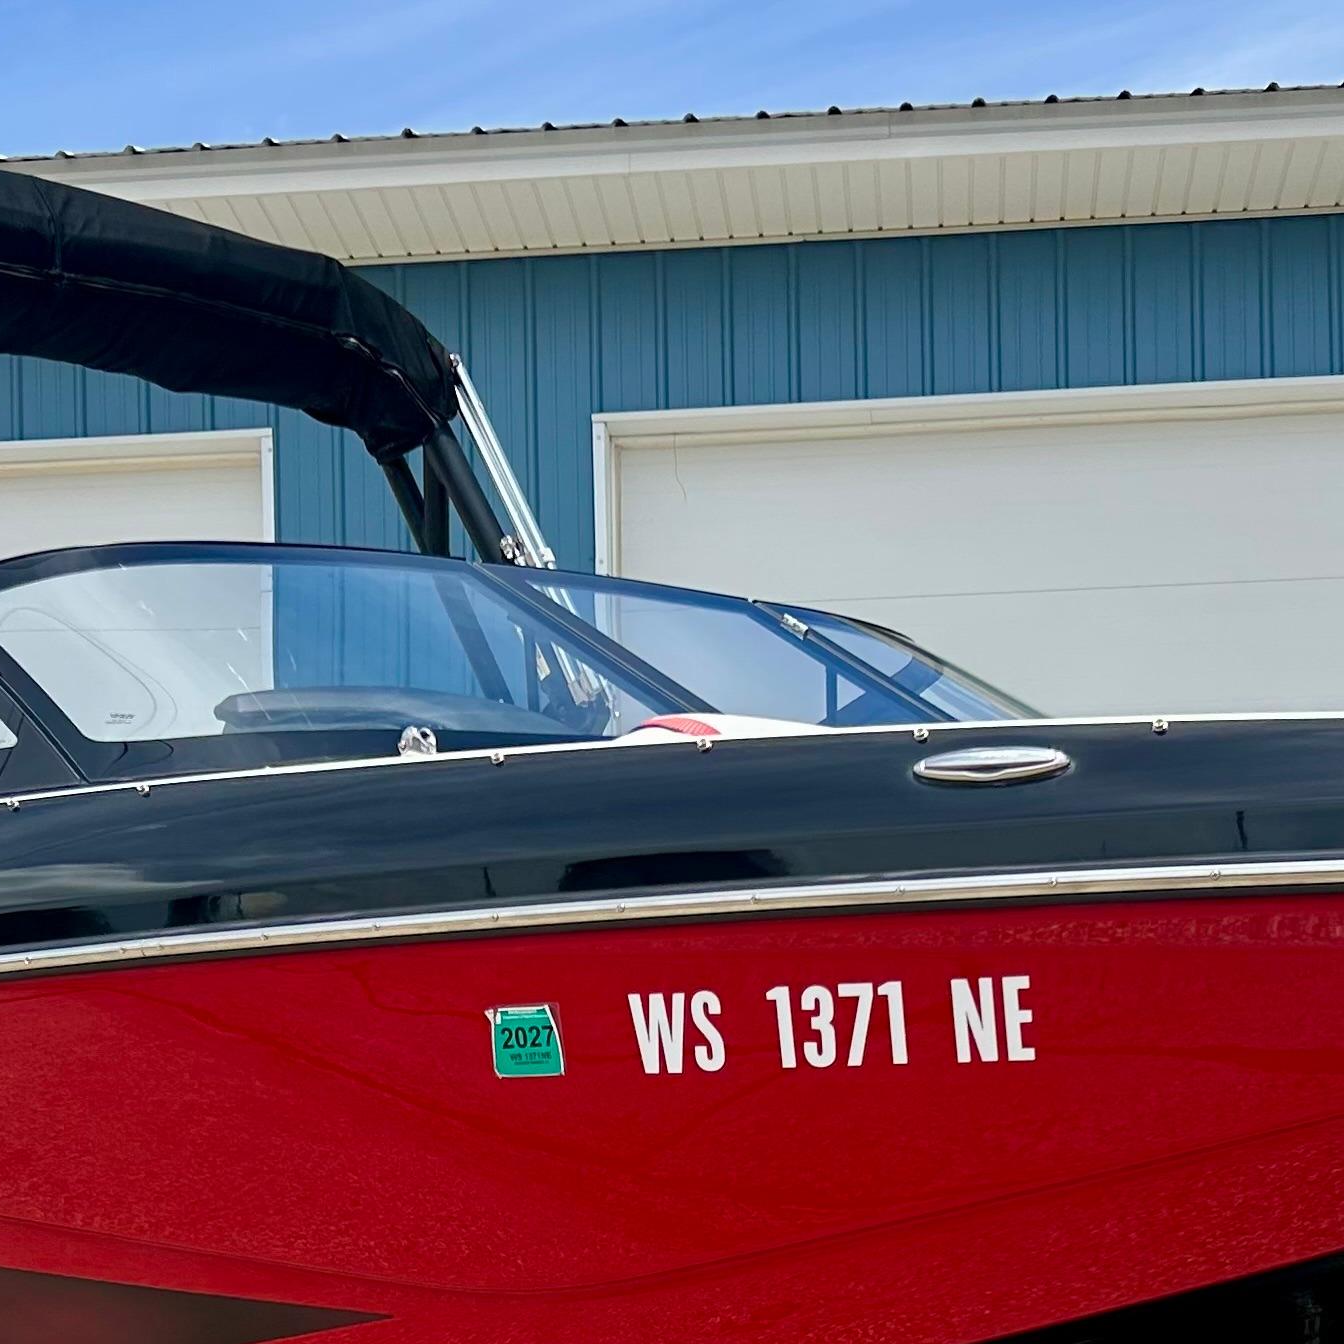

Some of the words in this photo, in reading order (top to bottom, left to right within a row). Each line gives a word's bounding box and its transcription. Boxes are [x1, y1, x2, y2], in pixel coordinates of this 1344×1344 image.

[501, 1025, 553, 1049] 2027
[627, 990, 726, 1074] WS
[766, 980, 909, 1068] 1371
[951, 975, 1036, 1063] NE
